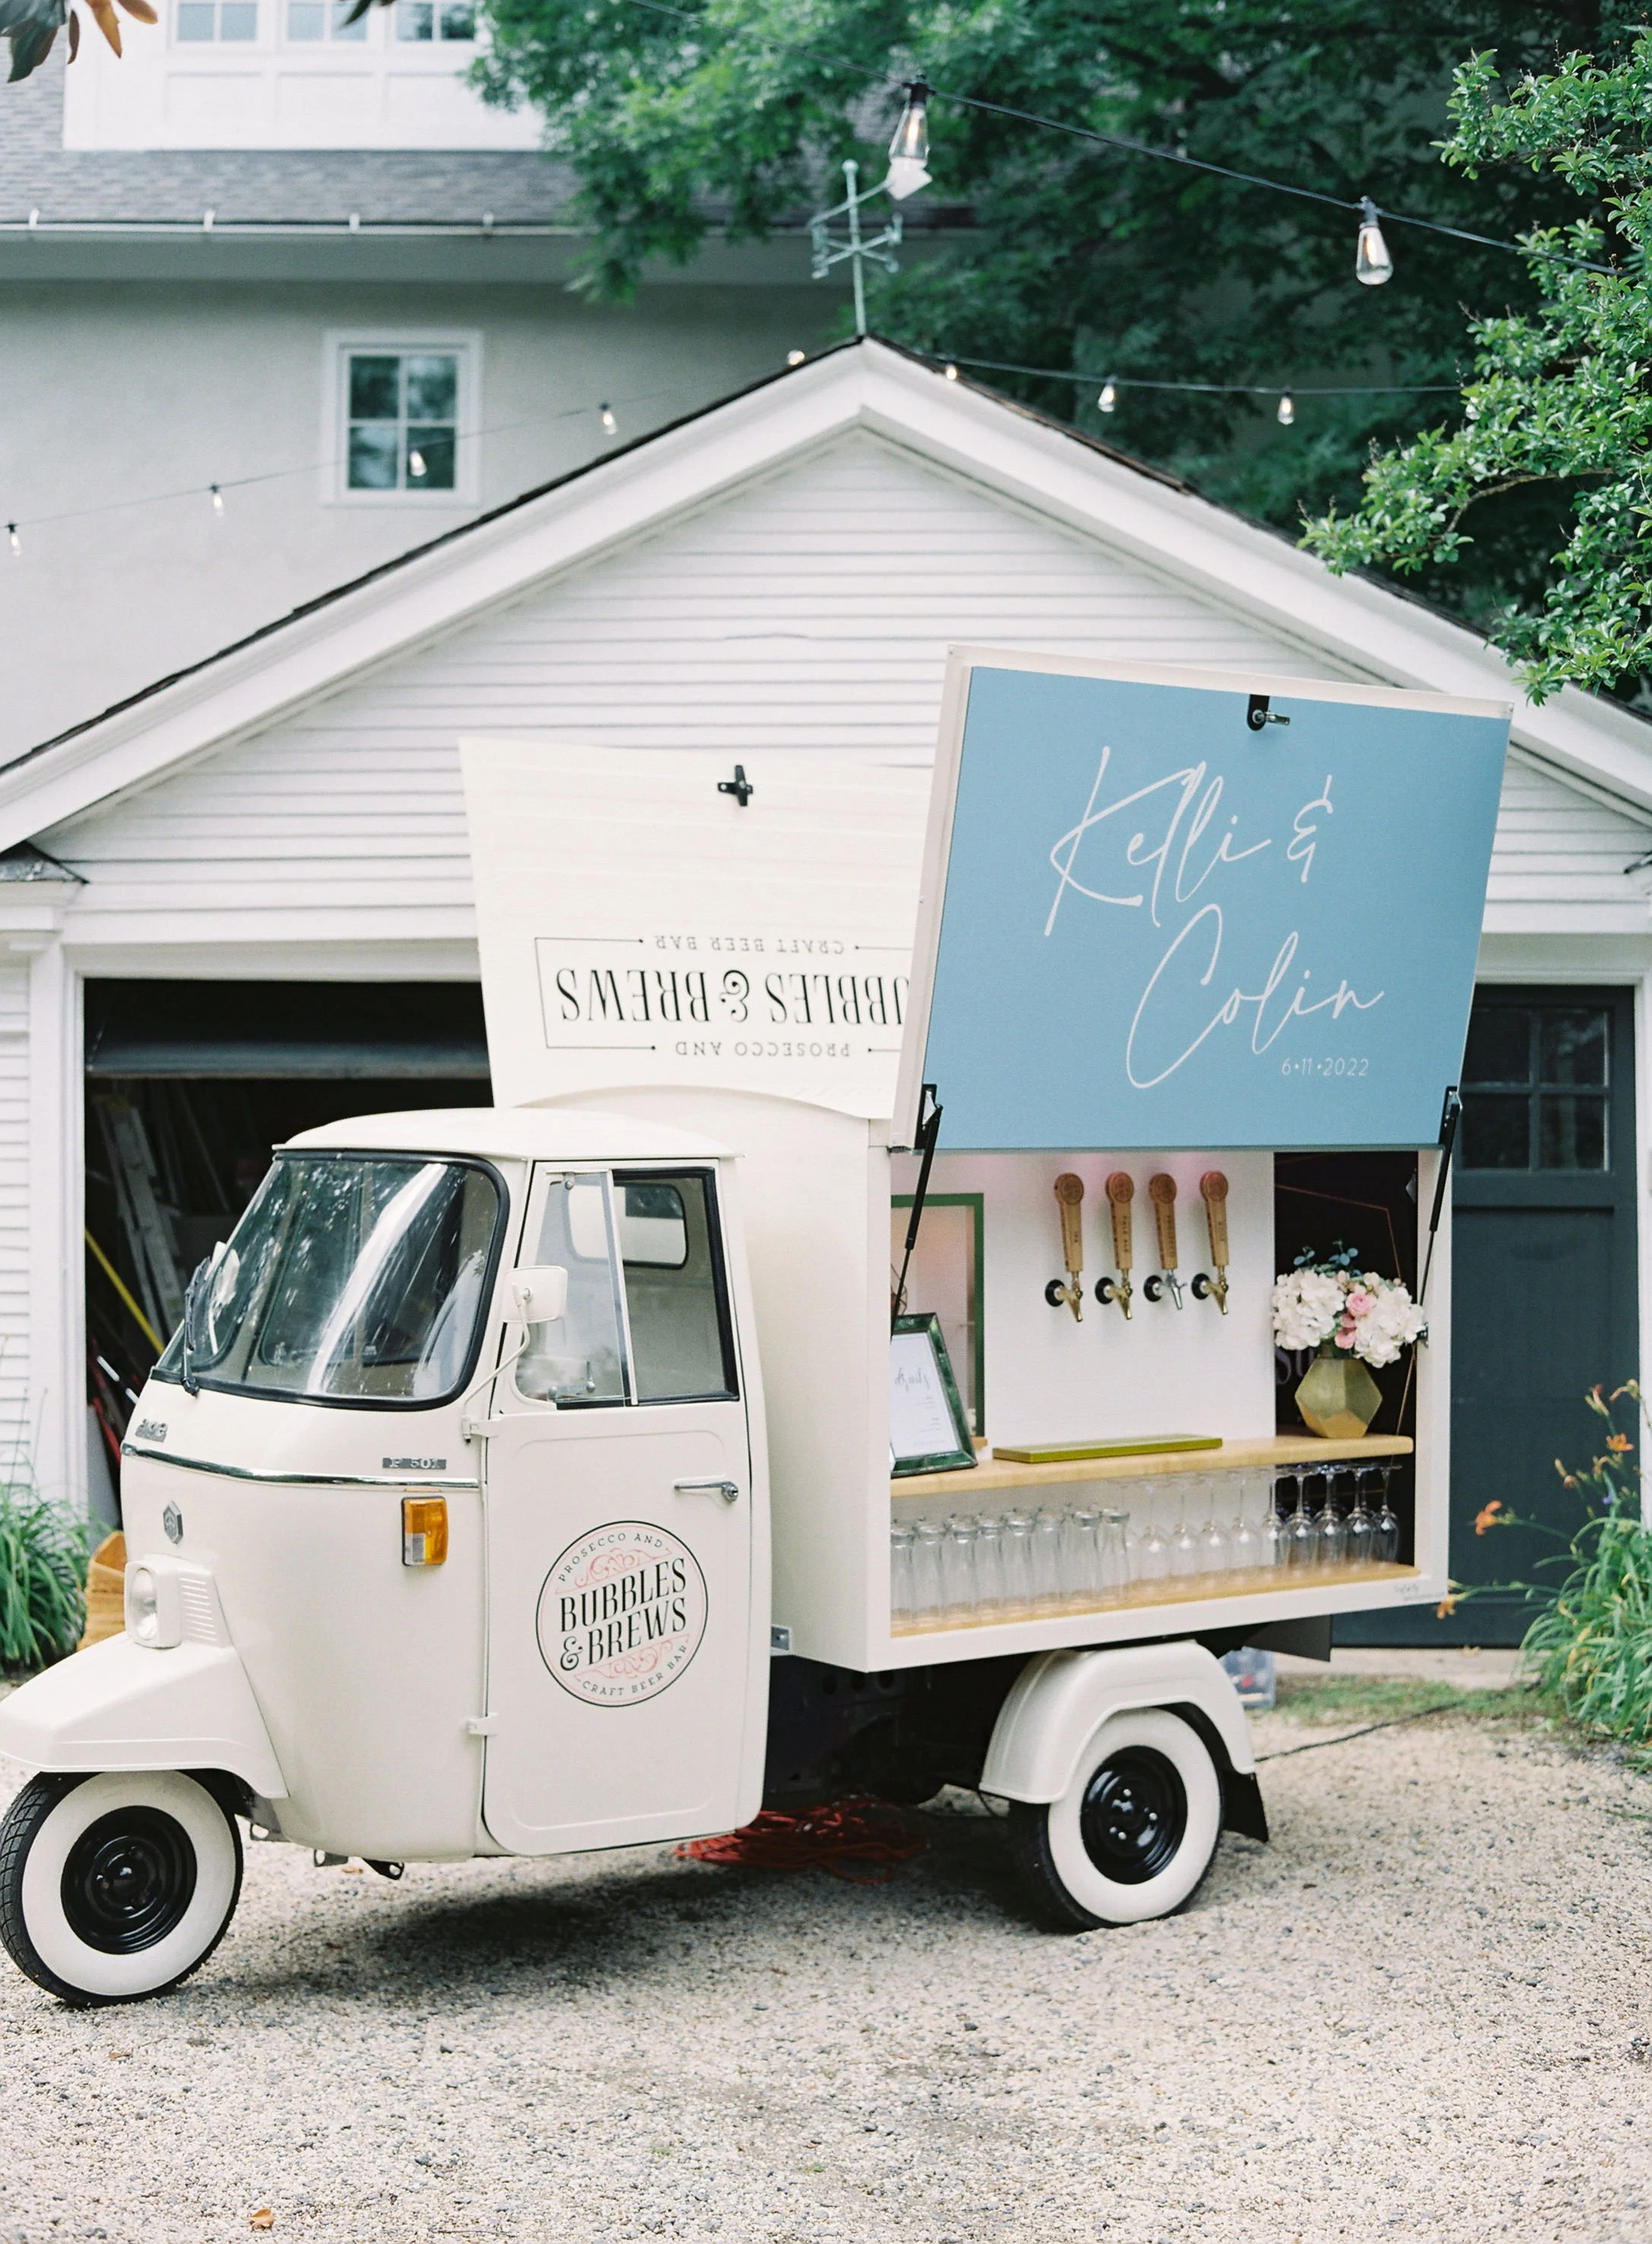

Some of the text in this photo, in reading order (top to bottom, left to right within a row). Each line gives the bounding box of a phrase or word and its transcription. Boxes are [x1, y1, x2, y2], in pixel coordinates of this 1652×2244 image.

[1044, 746, 1333, 937] Kelli &
[655, 935, 844, 955] CRAFT BEER BAR
[556, 968, 909, 1025] UBBLES & BREWS
[1126, 903, 1385, 1089] Colin
[675, 1041, 850, 1057] PROSECCO AND
[558, 1533, 663, 1582] PROSECCO AND
[560, 1558, 686, 1633] BUBBLES
[582, 1645, 688, 1695] CRAFT BEER BAR
